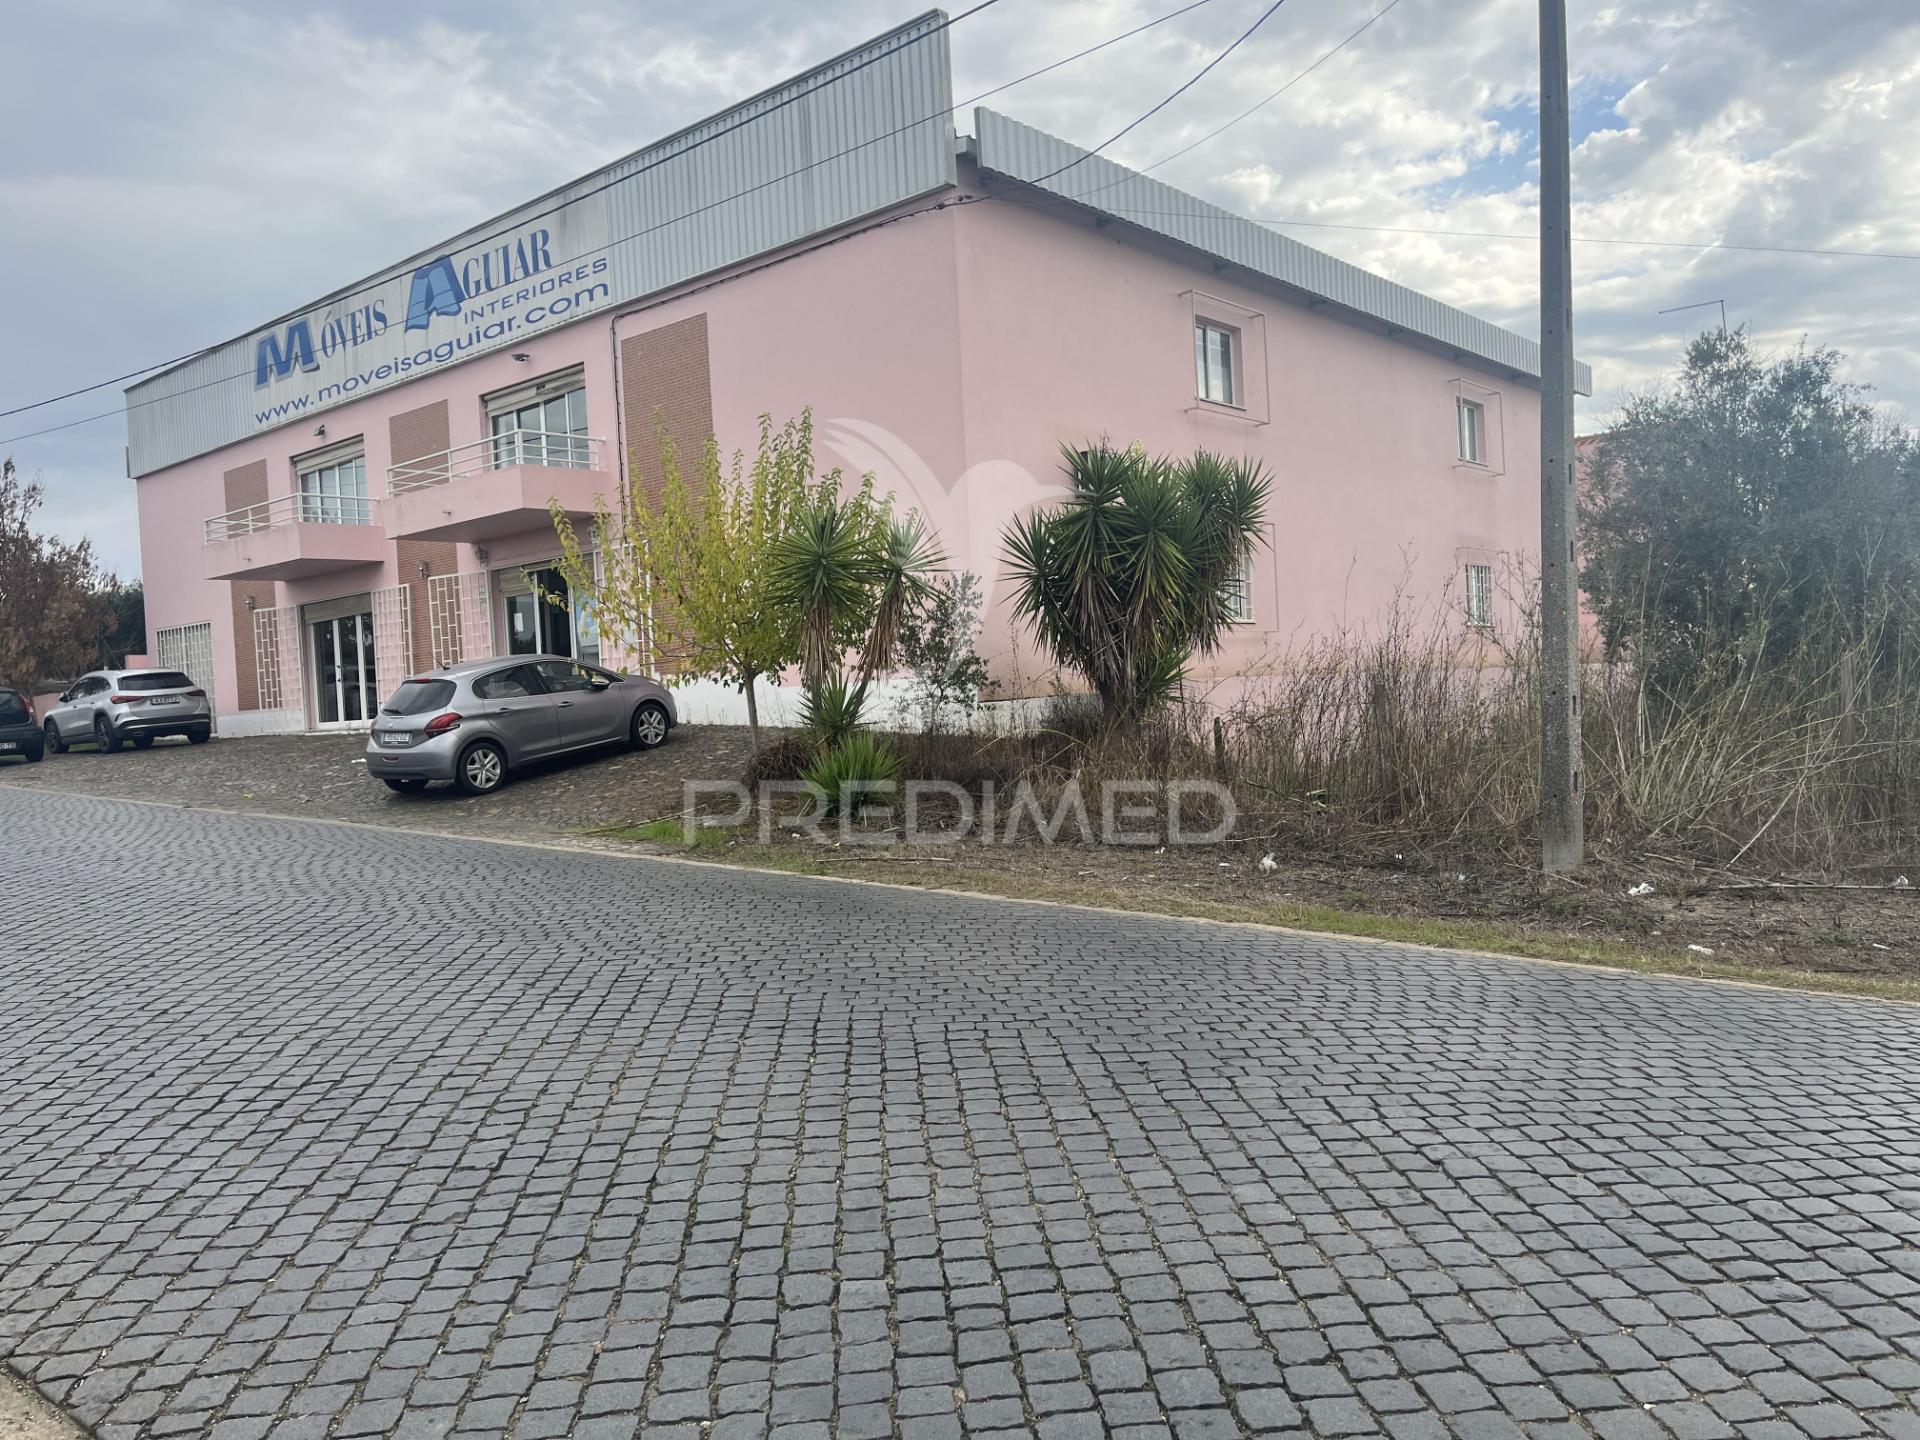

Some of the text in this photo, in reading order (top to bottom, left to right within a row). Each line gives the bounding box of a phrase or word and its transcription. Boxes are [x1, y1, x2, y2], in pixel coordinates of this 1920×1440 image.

[254, 283, 609, 424] www.moveisaguiar.com
[255, 228, 552, 391] MÓVEIS AGUIAR
[464, 257, 608, 324] INTERIORES
